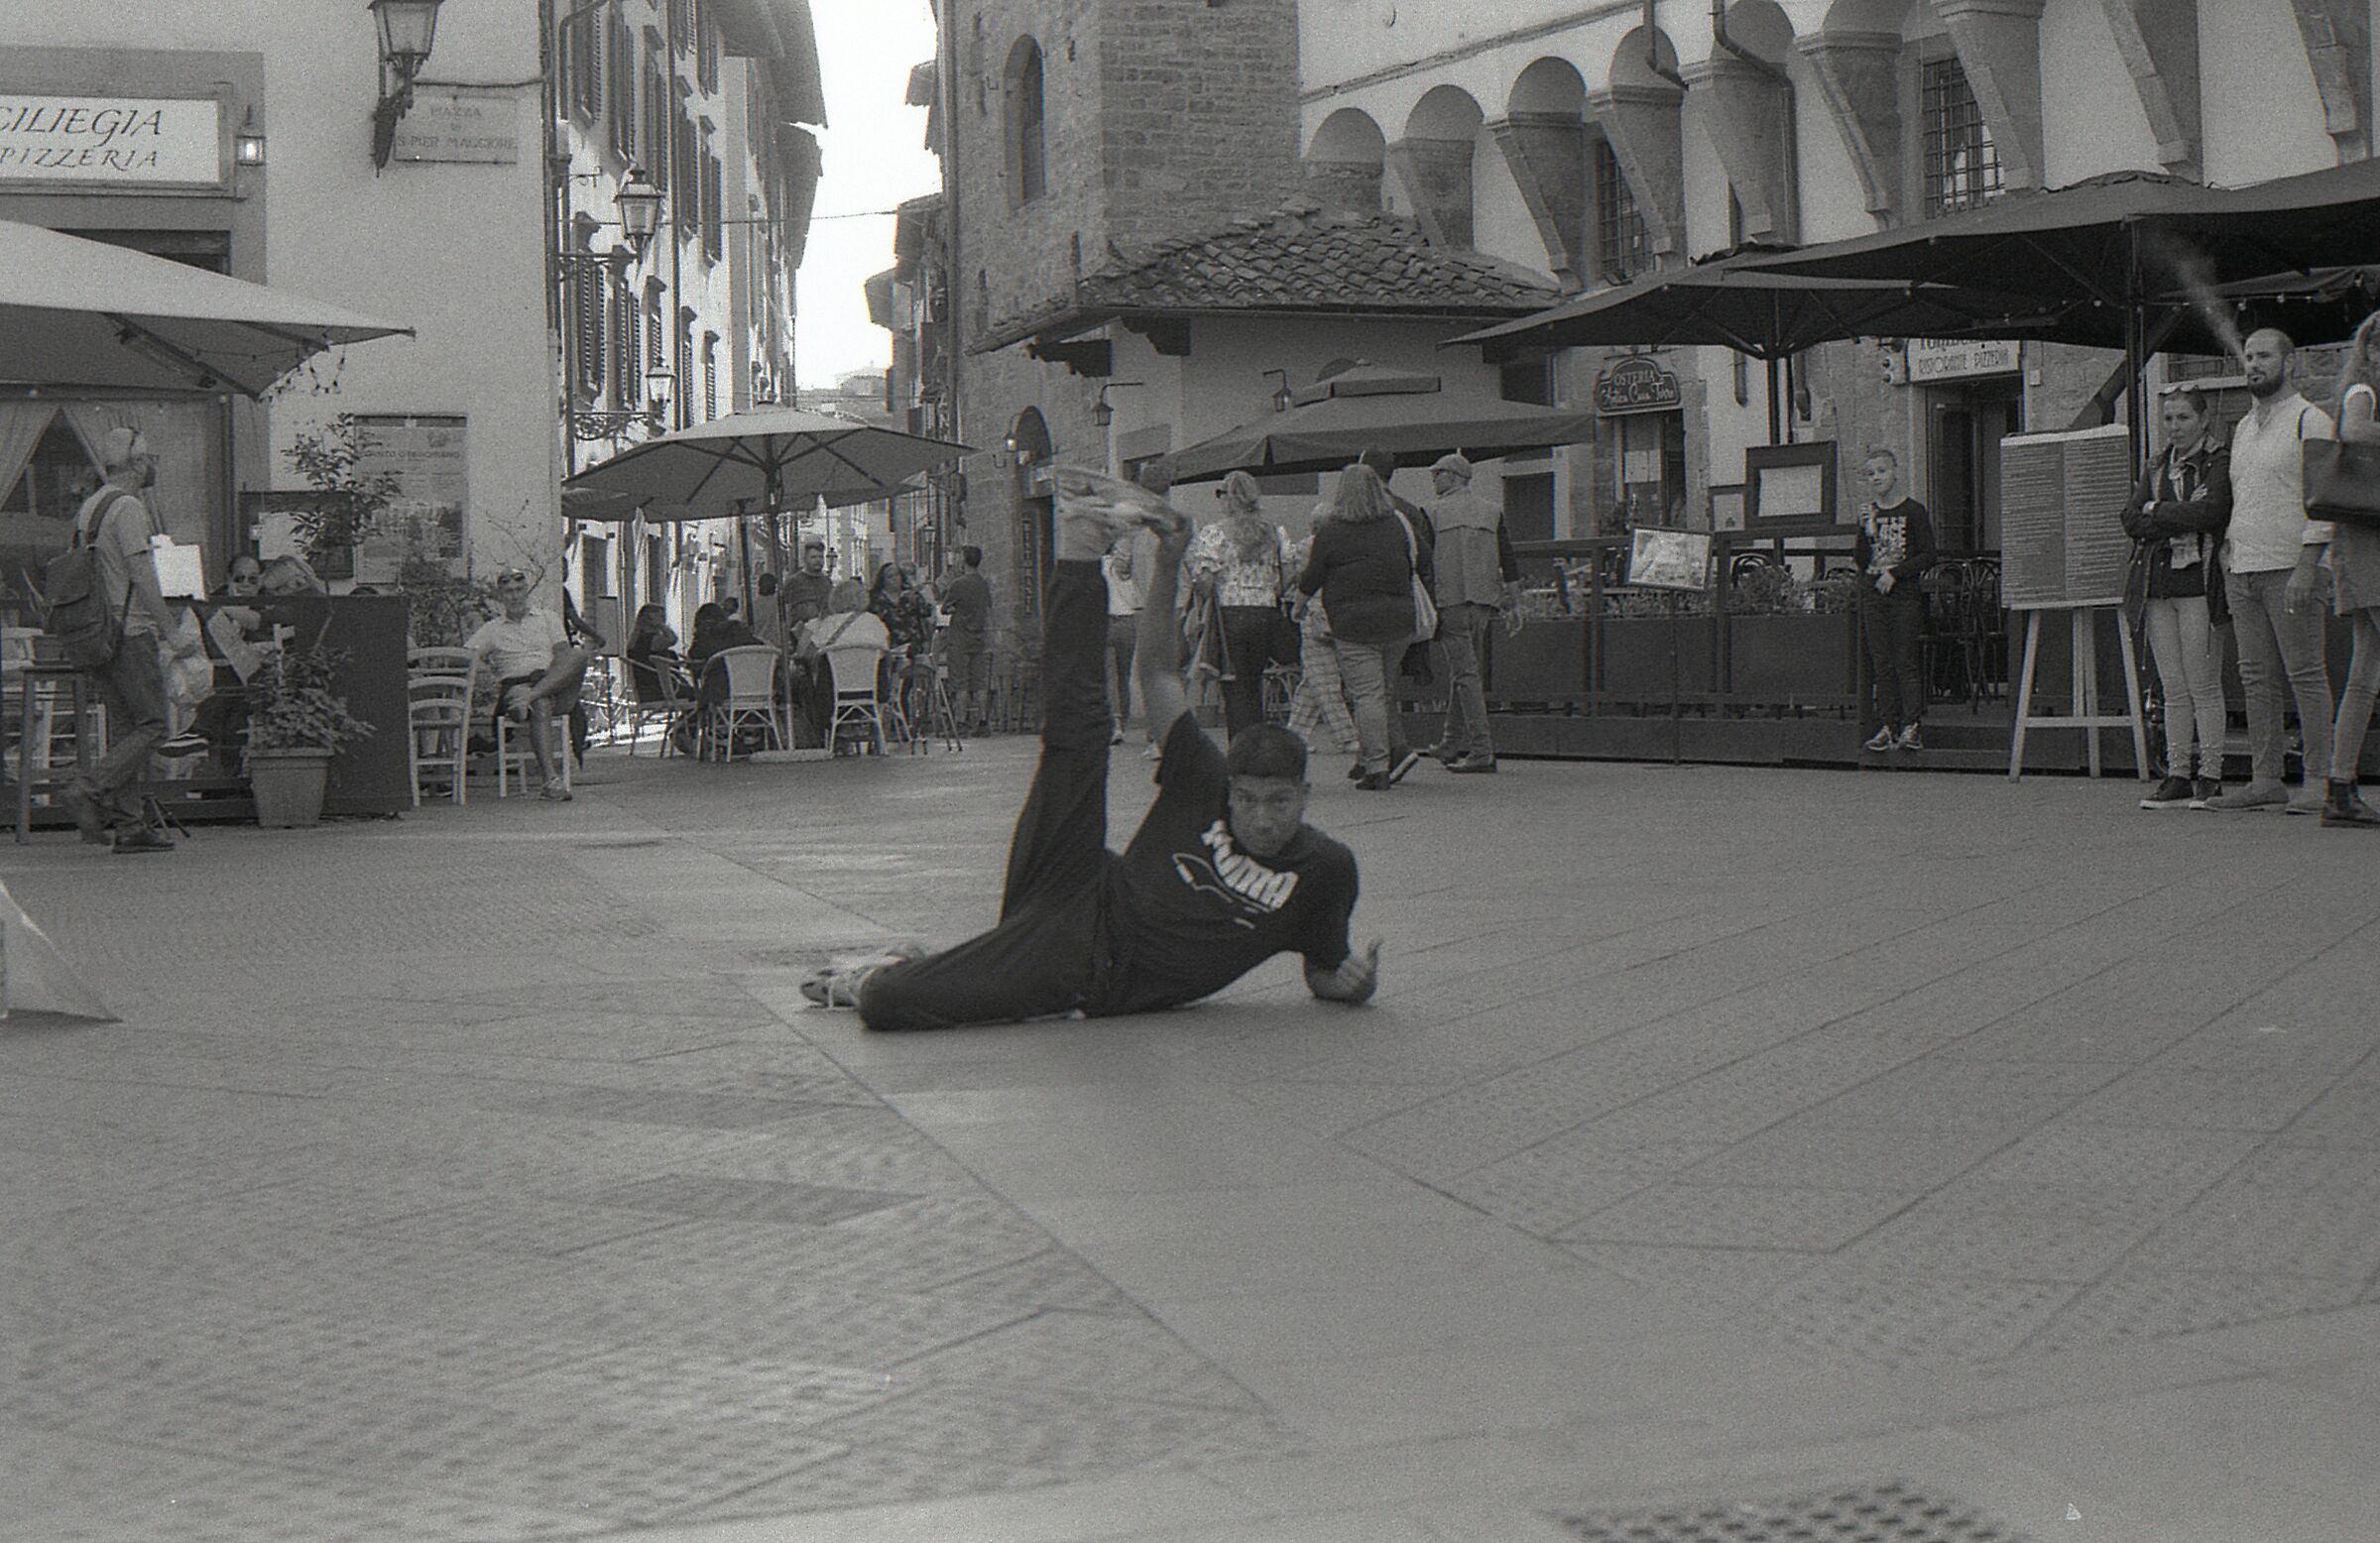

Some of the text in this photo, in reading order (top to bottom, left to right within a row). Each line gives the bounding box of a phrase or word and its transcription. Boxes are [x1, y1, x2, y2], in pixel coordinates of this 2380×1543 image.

[429, 106, 482, 117] PIAZZA
[411, 136, 439, 148] PIER
[0, 148, 157, 171] PIZZERIA
[1613, 370, 1655, 386] OSTERIA
